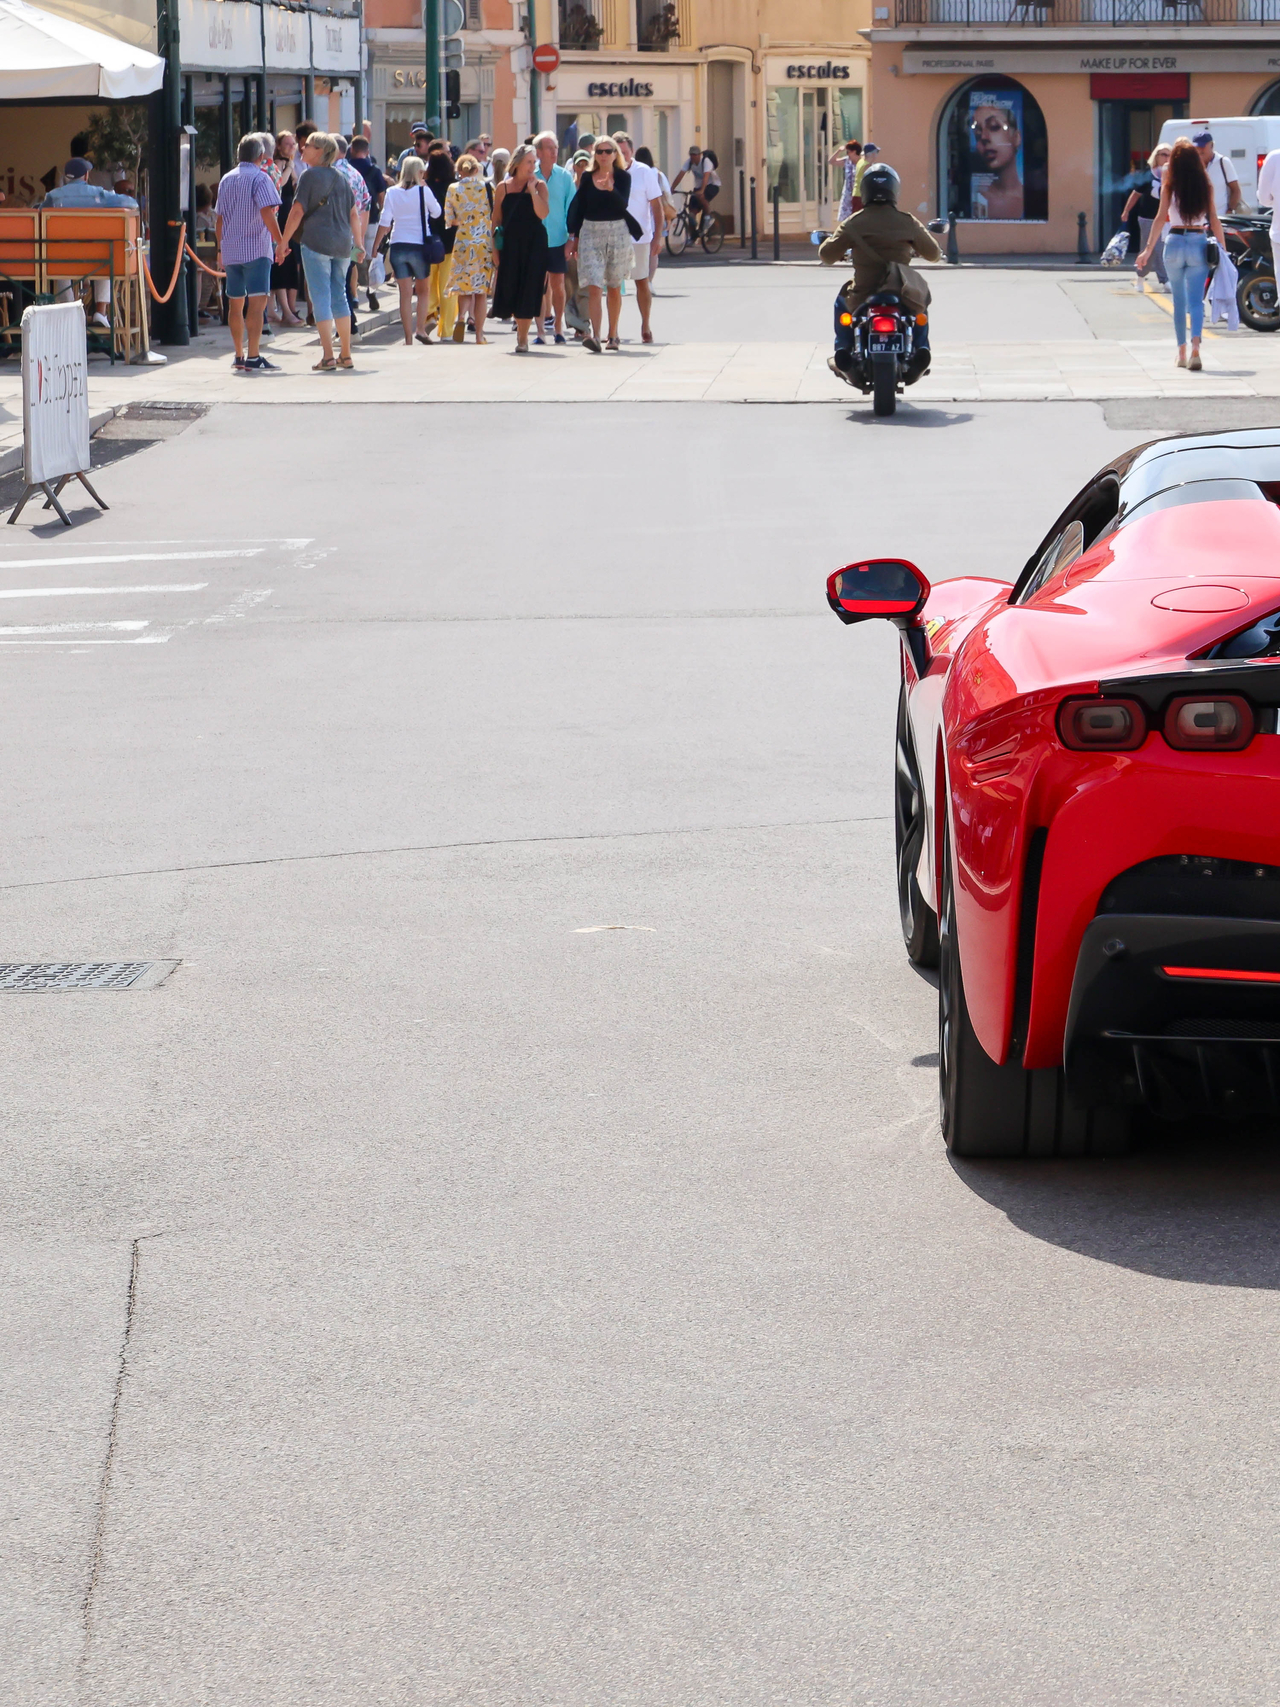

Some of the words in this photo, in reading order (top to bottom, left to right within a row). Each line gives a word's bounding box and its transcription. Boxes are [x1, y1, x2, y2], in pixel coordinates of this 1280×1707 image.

[922, 59, 974, 68] PROFESSIONAL
[976, 59, 995, 68] PARIS
[1080, 57, 1111, 69] MAKE
[1113, 57, 1127, 69] UP
[1129, 57, 1149, 69] FOR
[1152, 56, 1177, 69] EVER
